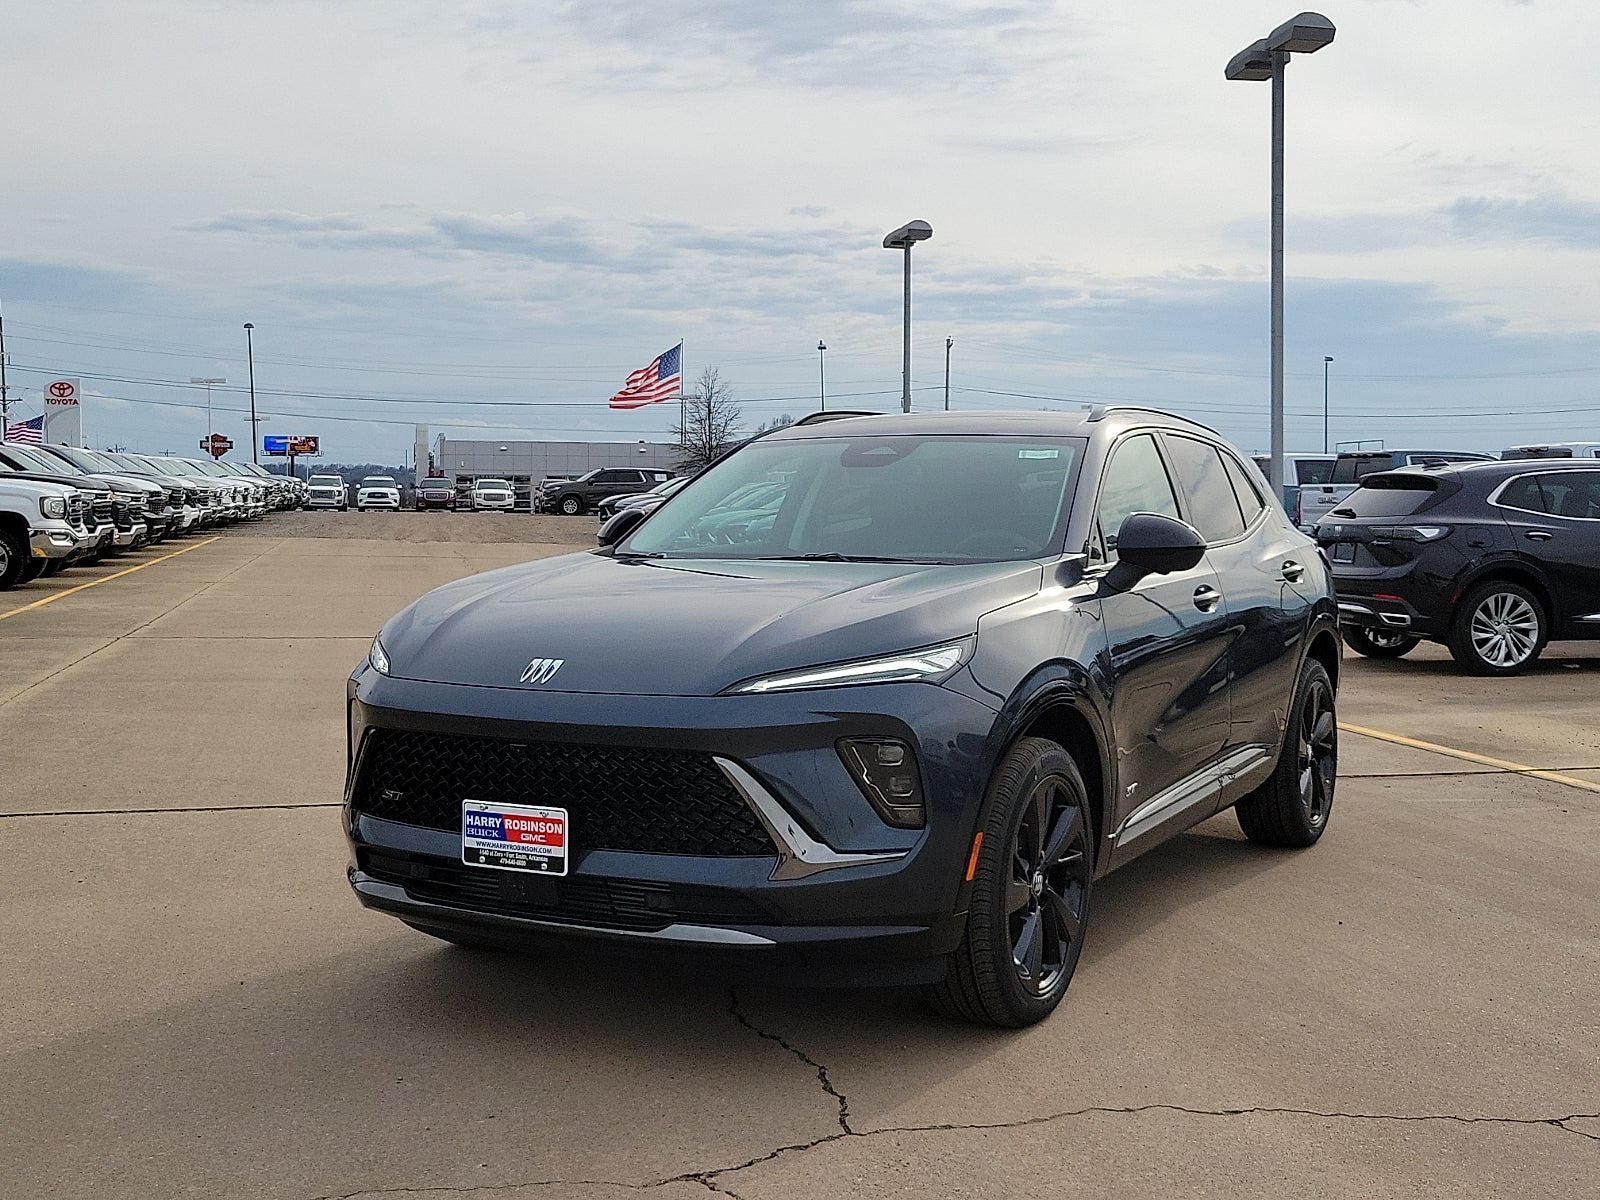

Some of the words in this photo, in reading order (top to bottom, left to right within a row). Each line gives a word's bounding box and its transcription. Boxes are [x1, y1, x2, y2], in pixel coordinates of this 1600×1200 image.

[45, 398, 79, 406] TOYOTA
[381, 789, 403, 800] ST
[466, 814, 502, 829] HARRY
[505, 819, 562, 834] ROBINSON
[466, 827, 500, 838] BUICK
[520, 833, 547, 843] GMC
[475, 841, 552, 854] WWW.HARRYROBINSON.COM
